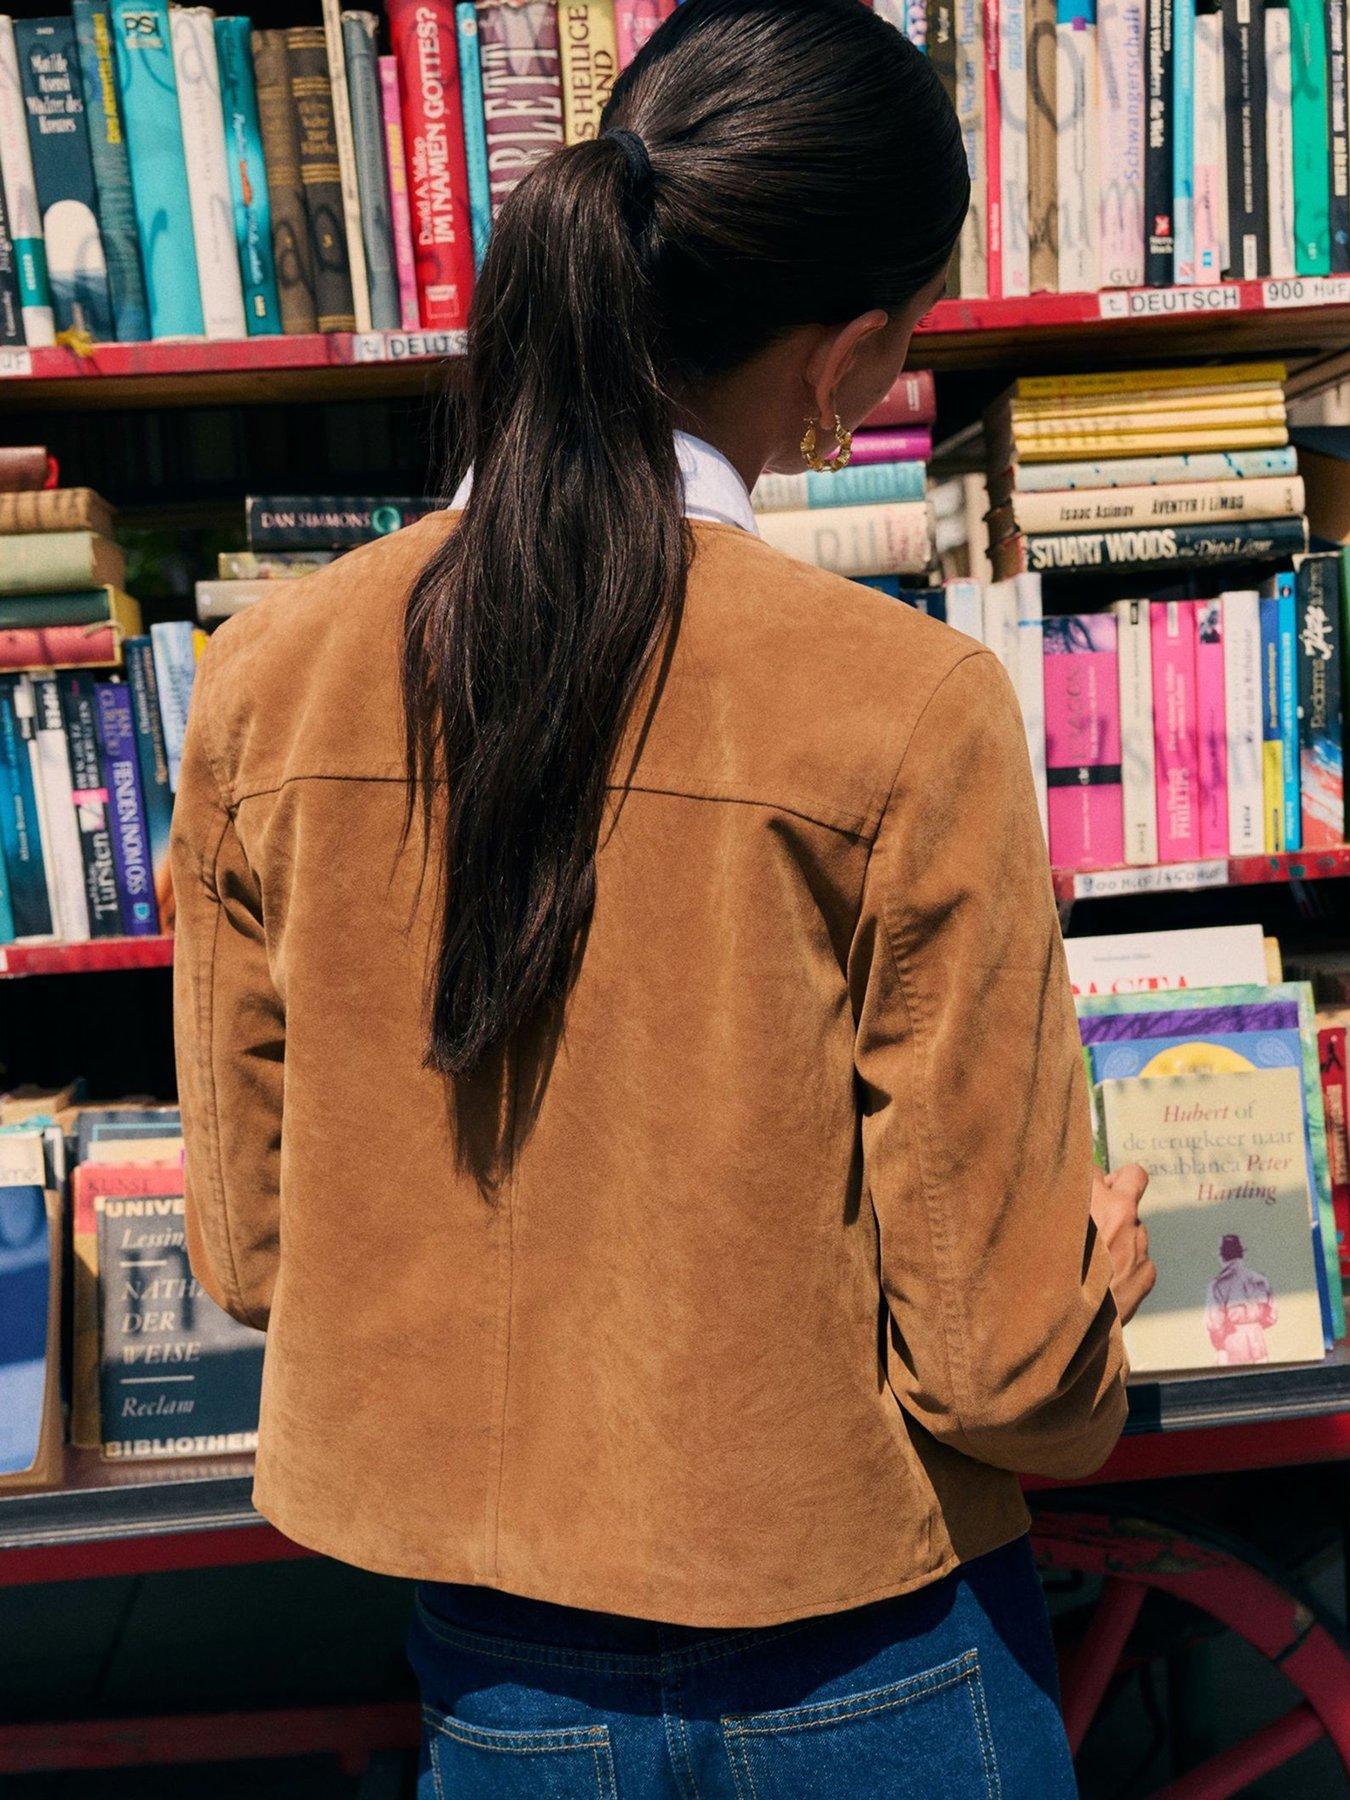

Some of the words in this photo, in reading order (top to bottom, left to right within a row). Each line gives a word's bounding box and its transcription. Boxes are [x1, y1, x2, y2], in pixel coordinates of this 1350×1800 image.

[125, 16, 161, 36] PSI
[416, 7, 445, 119] GOTTES?
[568, 4, 593, 114] HEILIGE
[593, 50, 613, 108] AND
[1125, 6, 1141, 181] Schwangerschaft
[480, 42, 564, 219] RLETT
[425, 122, 453, 207] NAMEN
[431, 210, 455, 245] IM
[1130, 288, 1238, 313] DEUTSCH
[1267, 281, 1304, 300] 900
[391, 335, 468, 357] DEUTS
[260, 512, 296, 528] DAN
[300, 512, 371, 528] SIMMONS
[1060, 507, 1091, 520] Isaac
[1096, 505, 1133, 518] Asimov
[1030, 534, 1104, 570] STUART
[1104, 529, 1178, 563] WOODS
[116, 707, 132, 738] JAN
[93, 831, 118, 920] Tursten
[126, 865, 148, 895] OSS
[1162, 1103, 1229, 1123] Hubert
[1234, 1099, 1256, 1119] of
[1123, 1133, 1146, 1150] de
[1152, 1130, 1245, 1154] terugkeer
[1252, 1131, 1295, 1147] naar
[1246, 1153, 1293, 1172] Peter
[105, 1199, 184, 1218] UNIVE
[121, 1227, 186, 1250] Lessin
[121, 1277, 206, 1300] NATH
[121, 1311, 176, 1333] DER
[121, 1341, 201, 1365] WEISE
[121, 1394, 194, 1418] Reclam
[105, 1431, 259, 1457] BIBLIOTHEK
